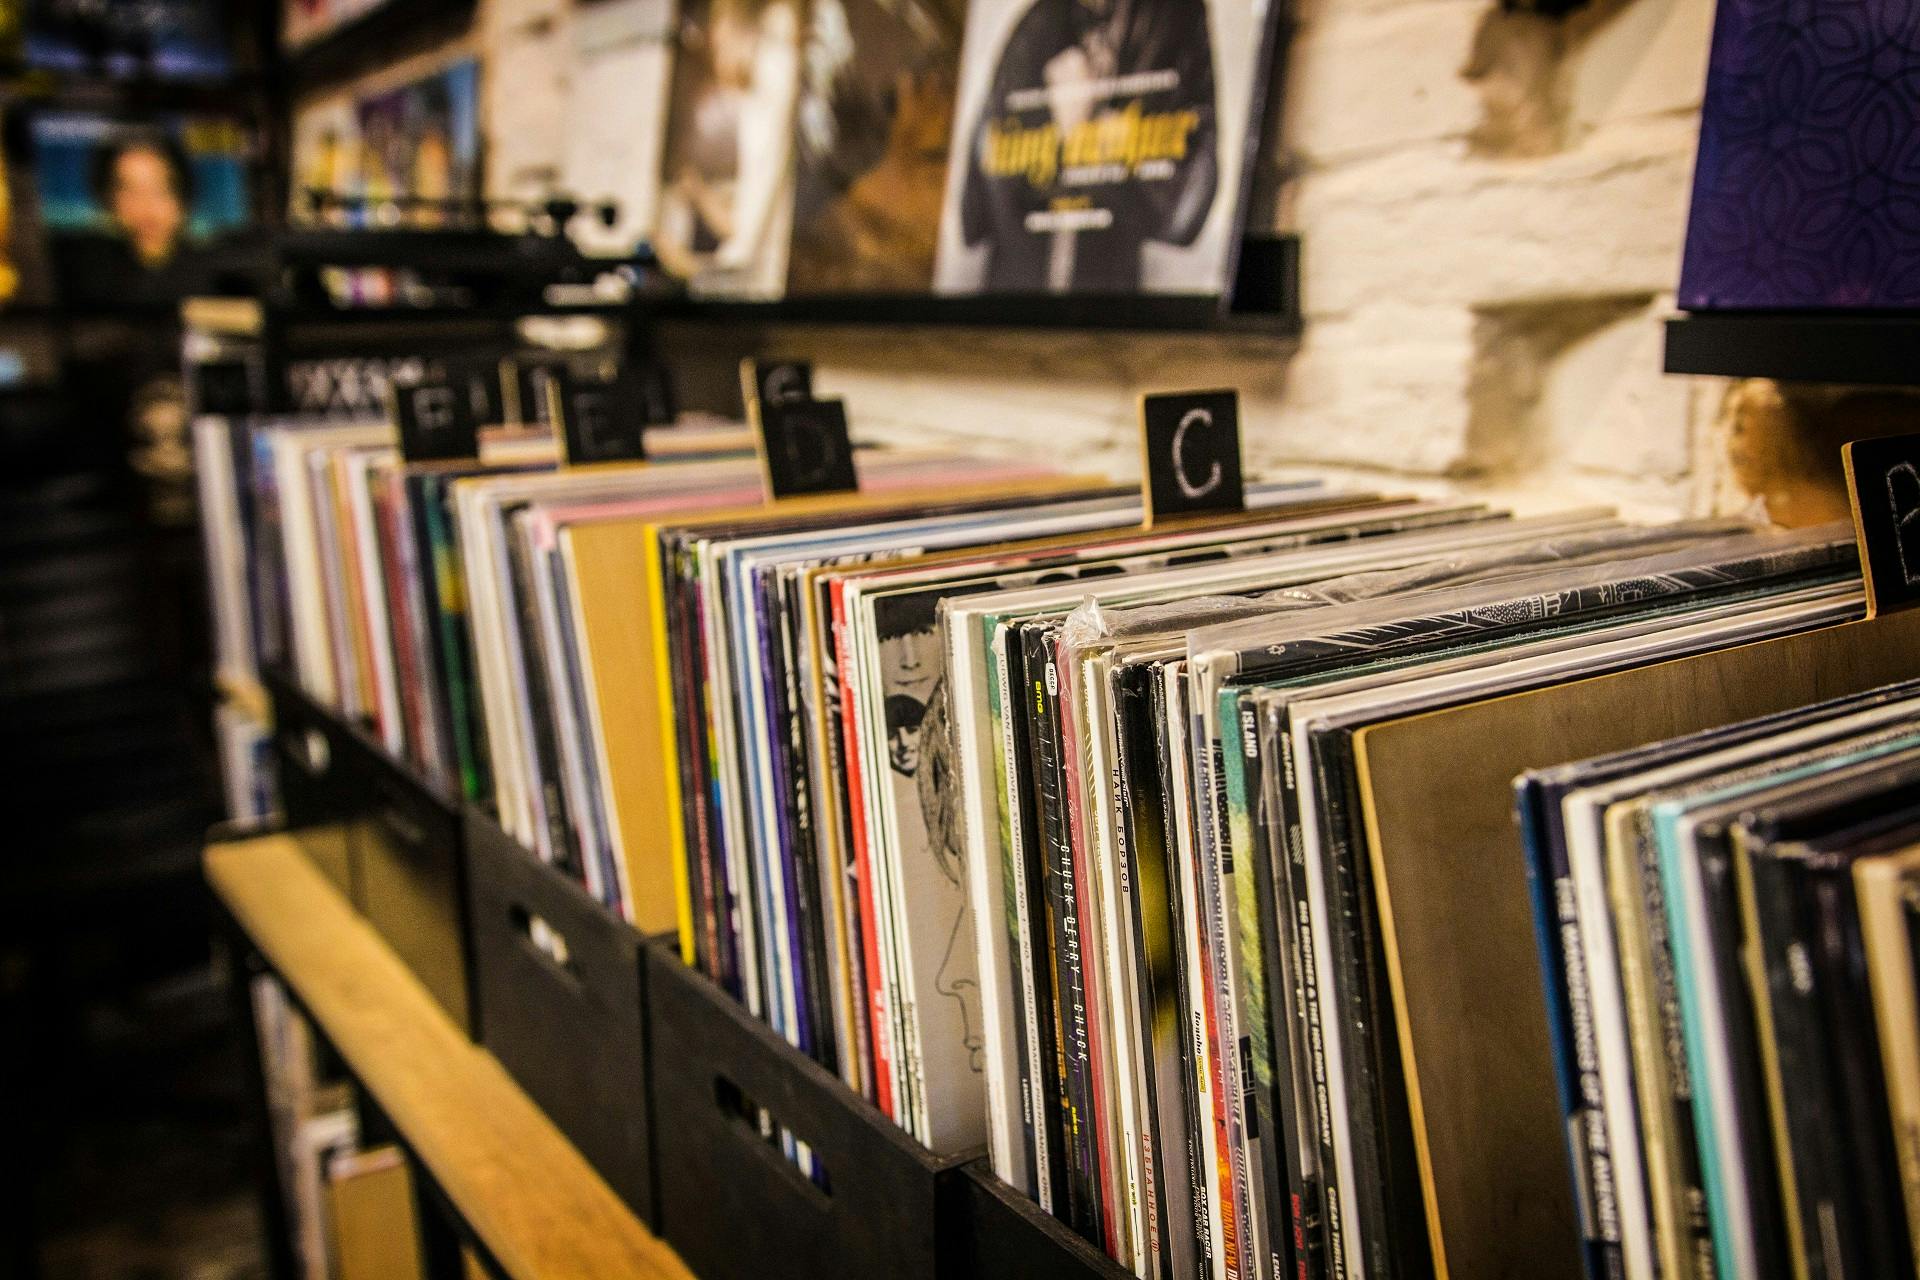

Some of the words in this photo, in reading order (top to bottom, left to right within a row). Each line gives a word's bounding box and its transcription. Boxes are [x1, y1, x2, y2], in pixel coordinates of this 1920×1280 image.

[1170, 407, 1222, 499] C
[1241, 710, 1258, 757] ISLAND
[1060, 845, 1074, 904] CHUCK
[1117, 826, 1128, 892] БОРЗОВ
[1297, 900, 1309, 923] BIG
[1066, 916, 1080, 973] BERRY
[1298, 925, 1316, 985] BROTHER
[1025, 984, 1035, 1025] POLISH
[1305, 987, 1316, 998] &
[1307, 1000, 1320, 1025] THE
[1029, 1028, 1039, 1084] CHAMBER
[1073, 1004, 1087, 1061] CHUCK
[1309, 1027, 1326, 1082] HOLDING
[1021, 1078, 1031, 1123] LEMONADE
[1315, 1084, 1332, 1146] COMPANY
[1142, 1134, 1156, 1233] ИЗБРАННОЕ
[1326, 1186, 1339, 1229] CHEAP
[1203, 1227, 1211, 1258] RACER
[1221, 1200, 1235, 1239] BRAND
[1224, 1240, 1237, 1268] NEW
[1331, 1231, 1345, 1280] THRILLS
